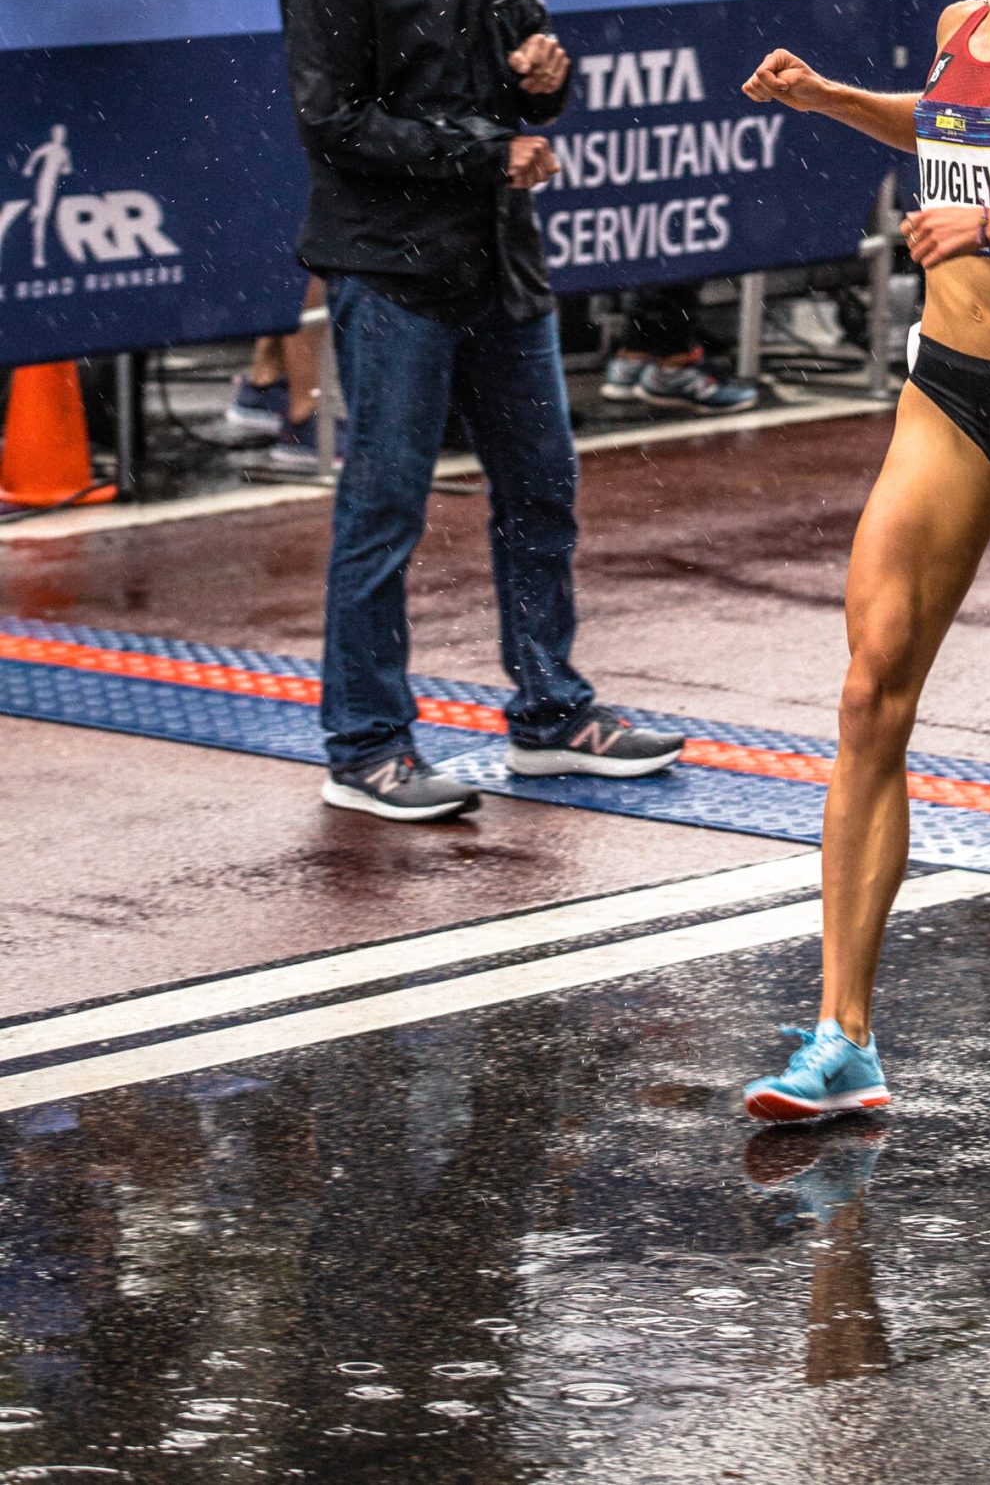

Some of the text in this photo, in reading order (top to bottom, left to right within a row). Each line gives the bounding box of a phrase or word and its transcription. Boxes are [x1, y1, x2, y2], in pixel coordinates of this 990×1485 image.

[579, 47, 705, 111] TATA
[532, 114, 784, 193] NSULTANCY
[546, 194, 731, 268] SERVICES
